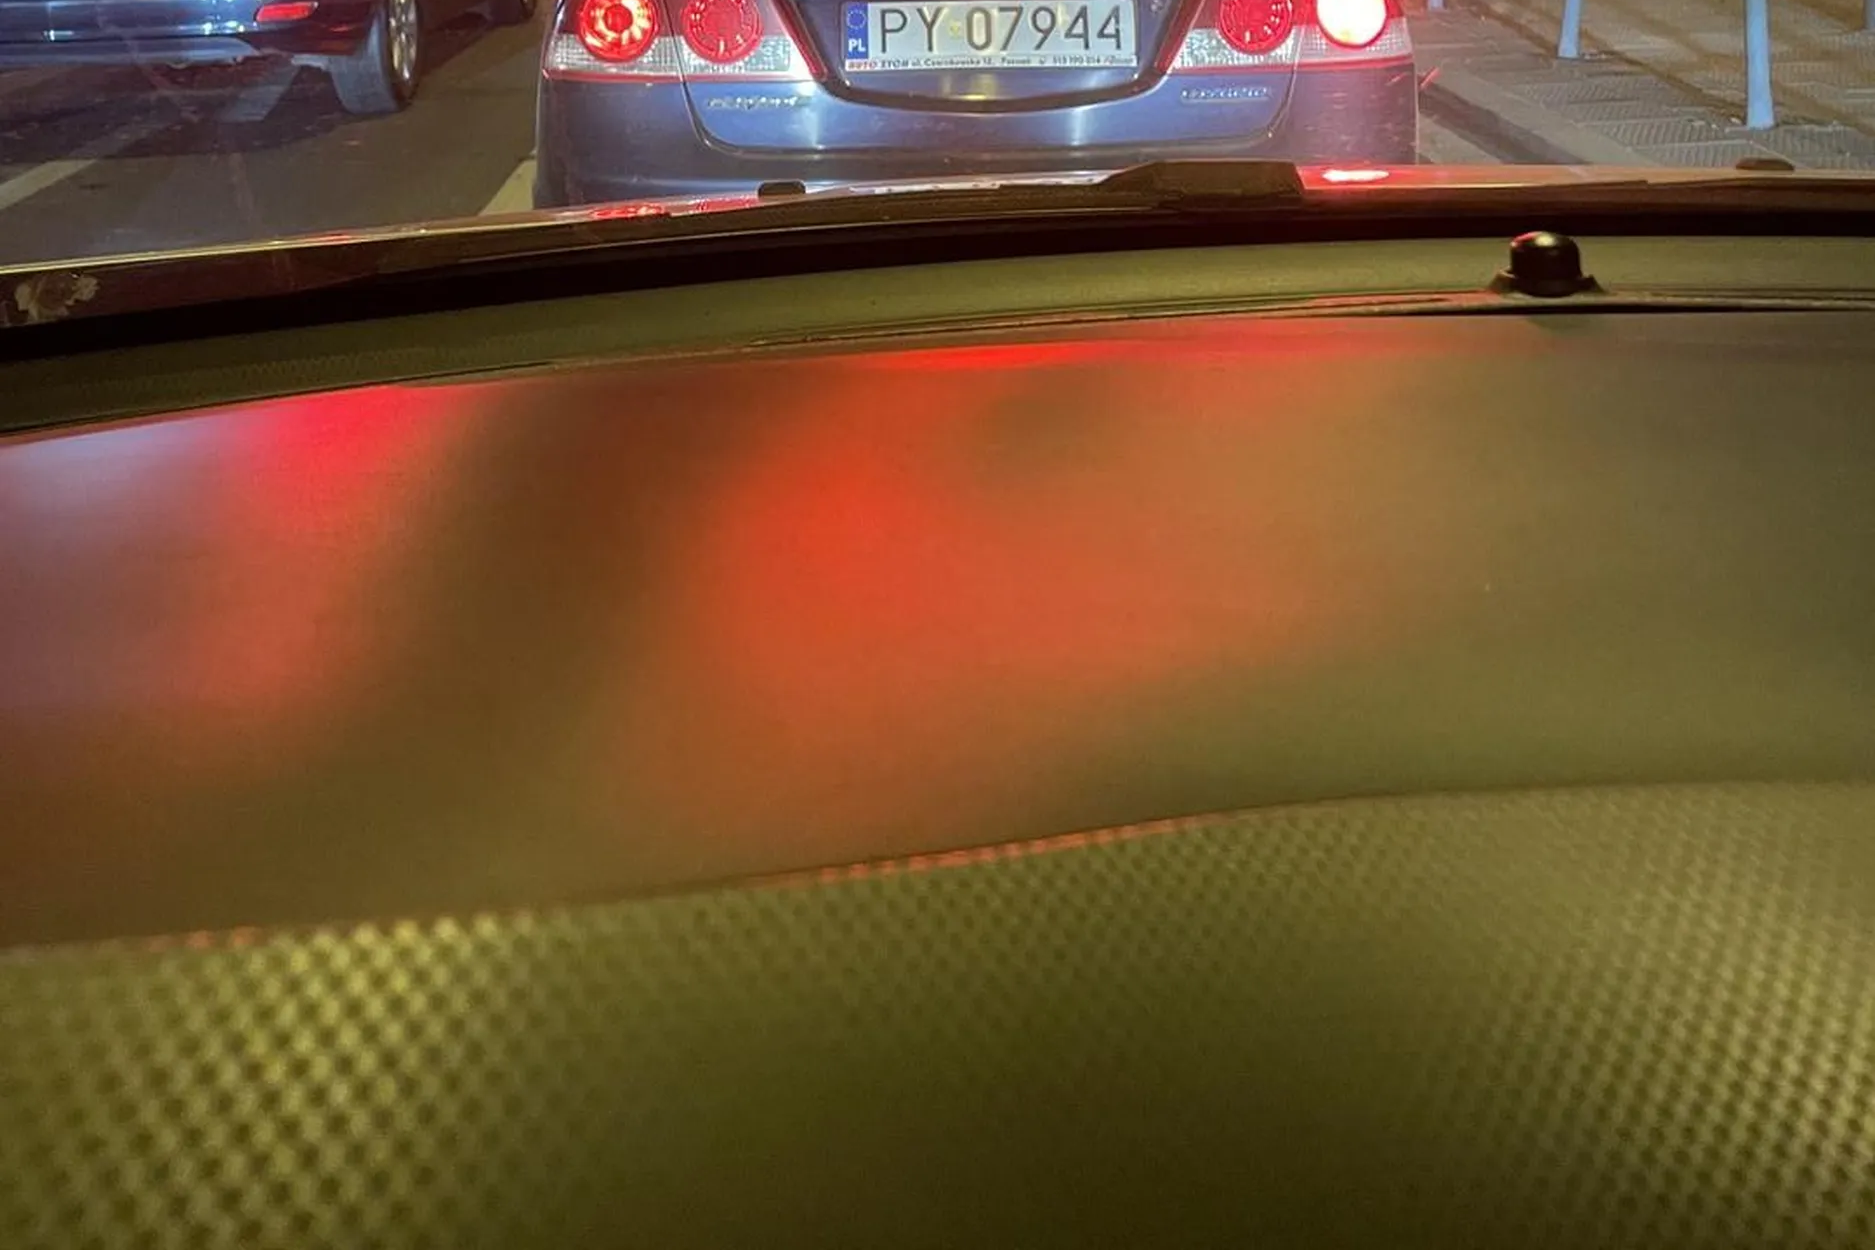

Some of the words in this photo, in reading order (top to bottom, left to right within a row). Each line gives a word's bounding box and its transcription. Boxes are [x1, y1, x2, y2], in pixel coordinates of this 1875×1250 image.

[879, 6, 946, 53] PY
[965, 4, 1123, 52] 07944
[848, 37, 866, 53] PL
